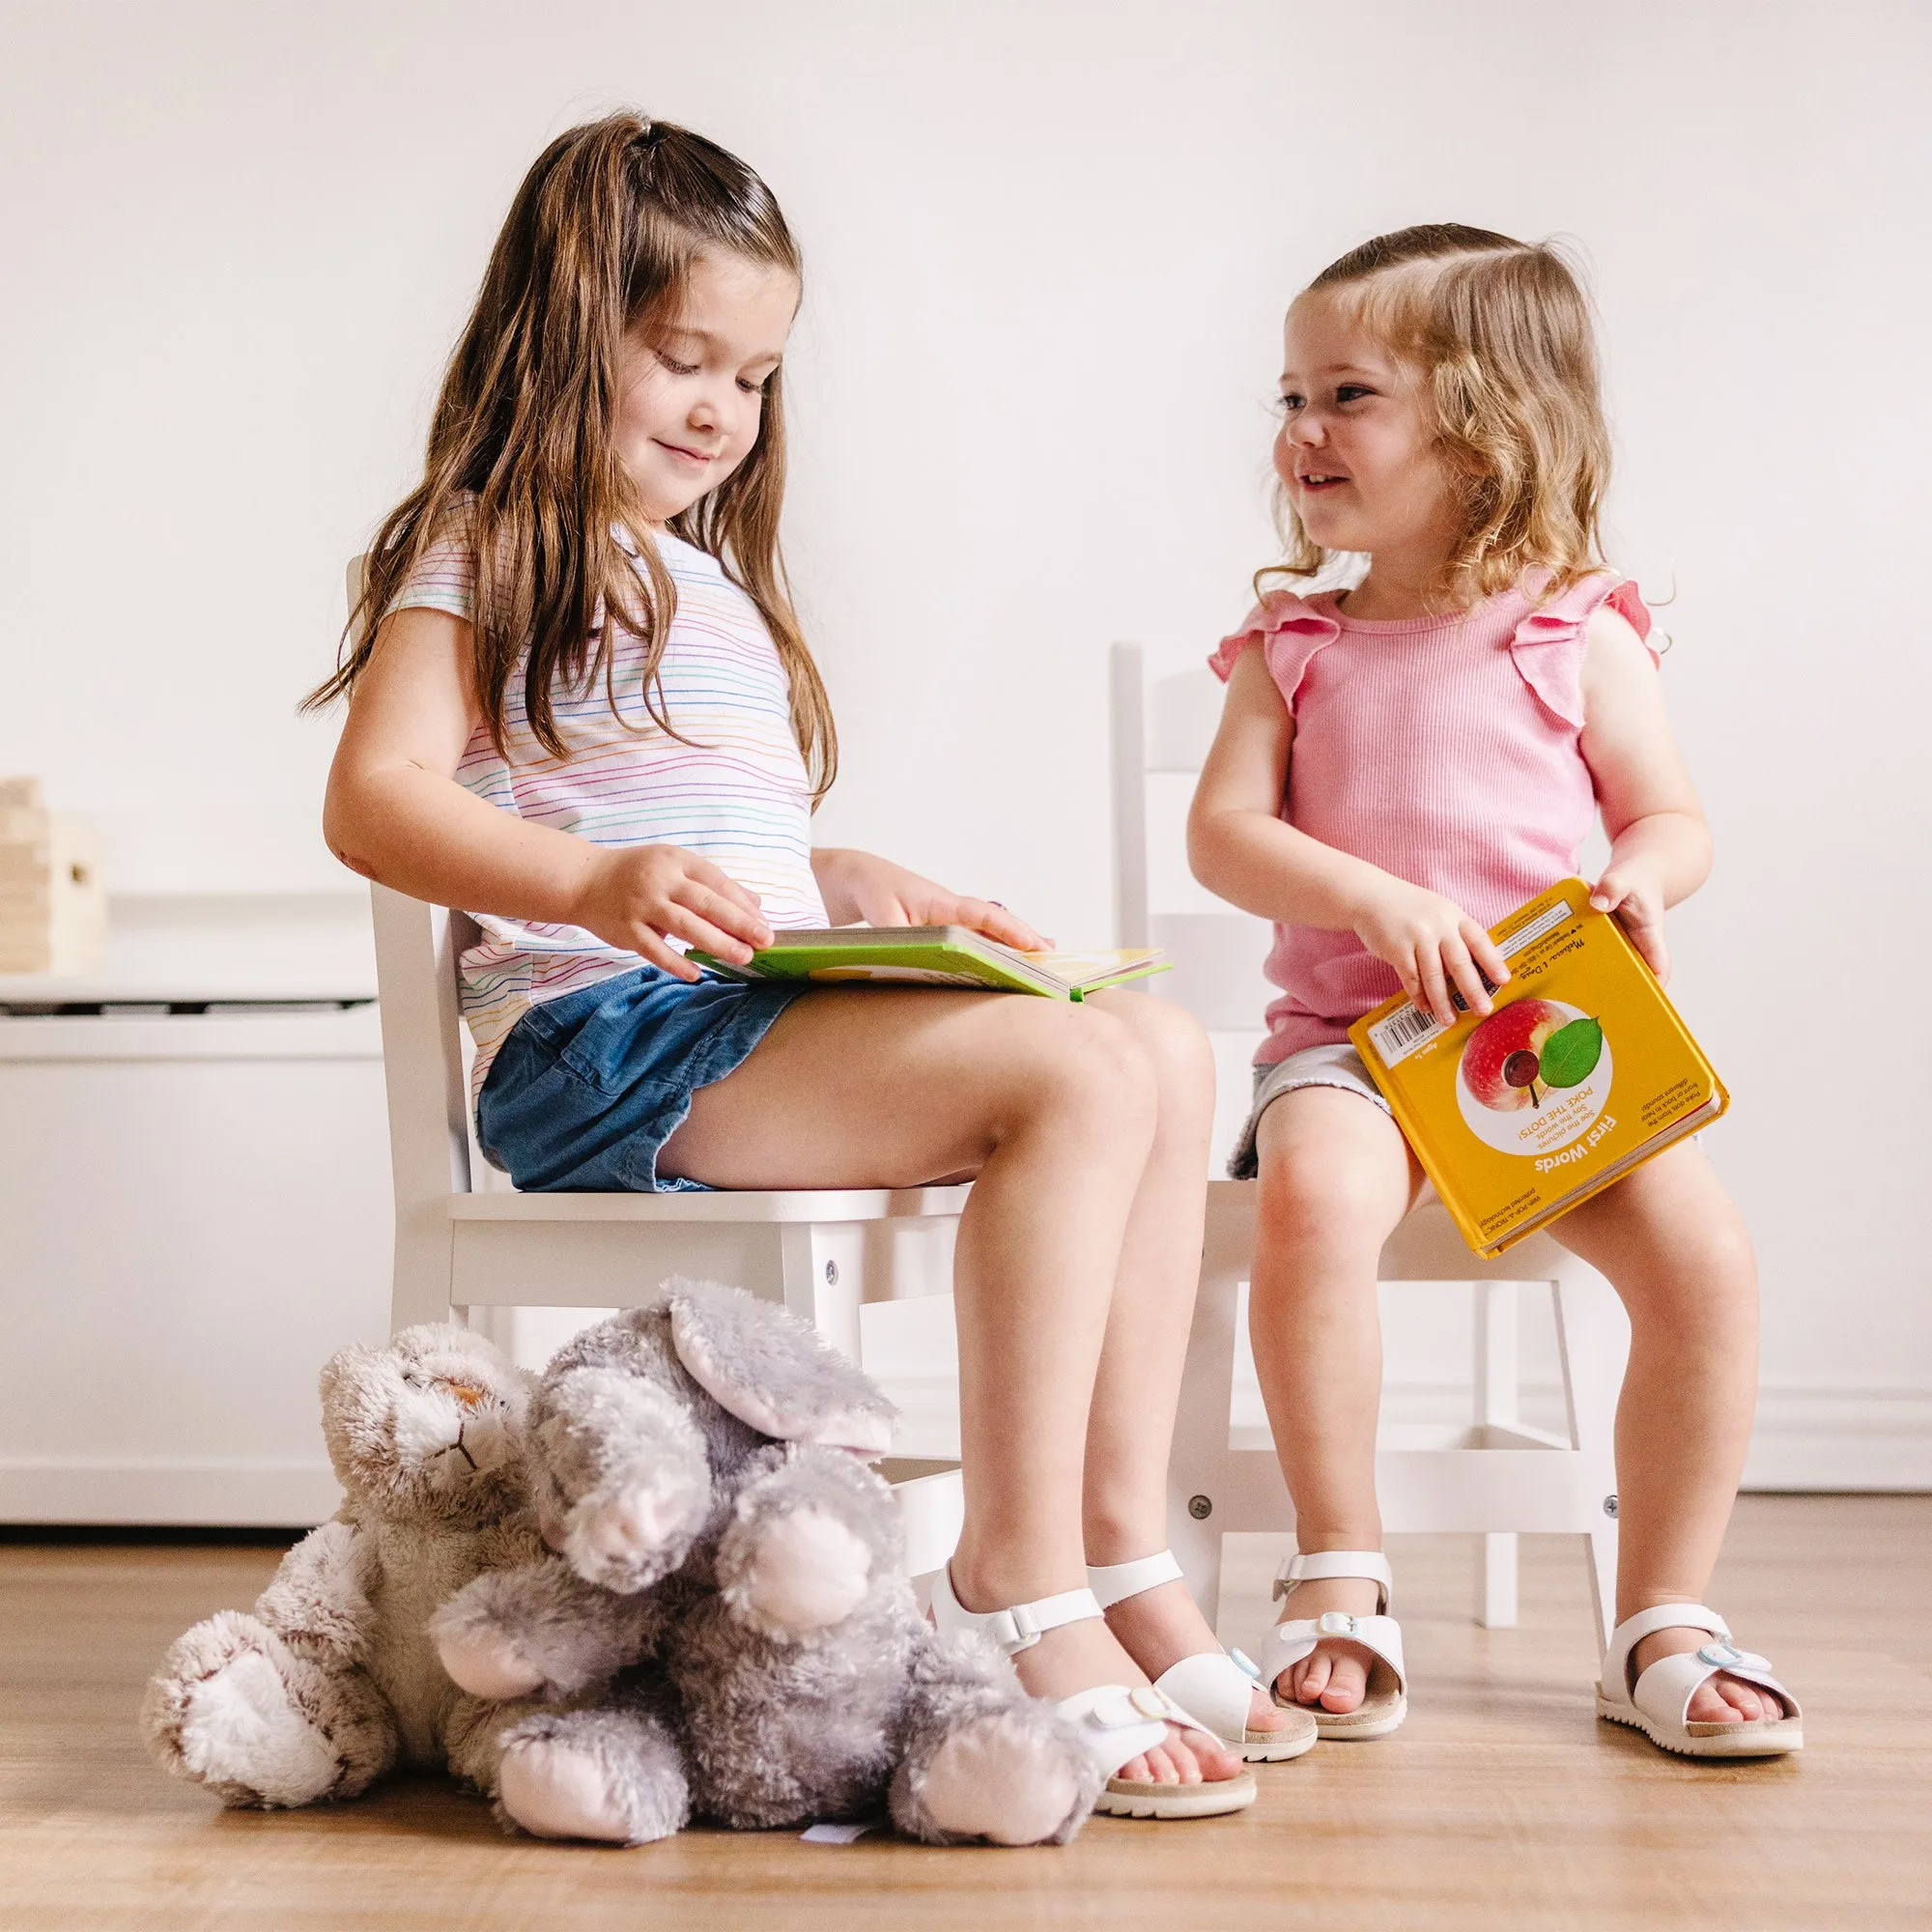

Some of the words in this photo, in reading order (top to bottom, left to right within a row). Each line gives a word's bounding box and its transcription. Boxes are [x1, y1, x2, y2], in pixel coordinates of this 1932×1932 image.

[1549, 938, 1584, 961] Melissa
[1519, 964, 1543, 980] Doug
[1663, 1079, 1688, 1095] different
[1683, 1082, 1697, 1094] front
[1566, 1086, 1593, 1108] POKE
[1662, 1095, 1676, 1108] back
[1684, 1090, 1700, 1103] Poke
[1547, 1103, 1567, 1121] THE
[1573, 1103, 1587, 1116] Say
[1671, 1099, 1685, 1112] dots
[1558, 1114, 1573, 1125] the
[1579, 1109, 1594, 1122] See
[1640, 1109, 1656, 1122] hear
[1657, 1109, 1672, 1122] from
[1518, 1117, 1547, 1140] DOTS!
[1567, 1120, 1580, 1131] the
[1646, 1118, 1658, 1128] the
[1584, 1114, 1617, 1147] First
[1534, 1144, 1588, 1174] Words
[1511, 1187, 1535, 1207] patented
